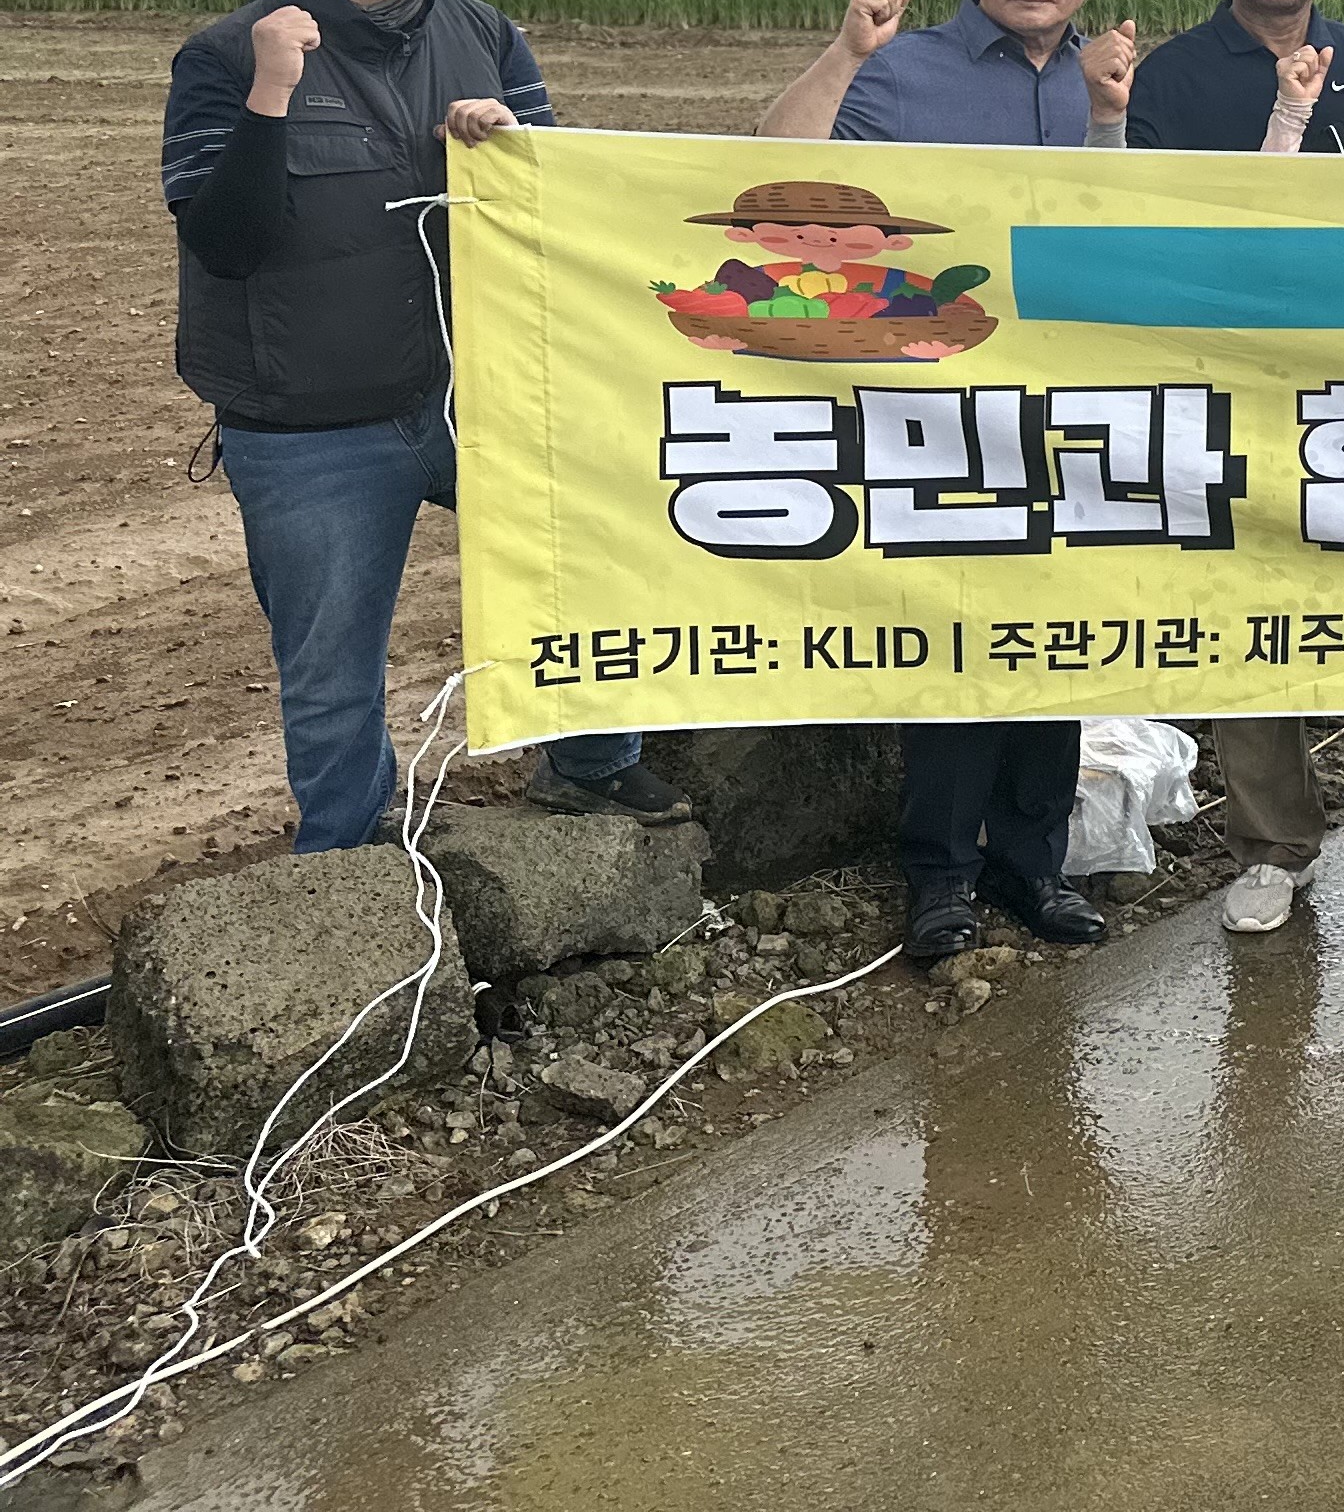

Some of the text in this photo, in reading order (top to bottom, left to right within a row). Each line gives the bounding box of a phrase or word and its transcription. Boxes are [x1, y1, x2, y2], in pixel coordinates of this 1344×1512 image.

[660, 381, 1247, 560] 농민과
[531, 625, 778, 687] 전담기관:
[804, 627, 928, 668] KLID
[989, 618, 1219, 671] 주관기관:
